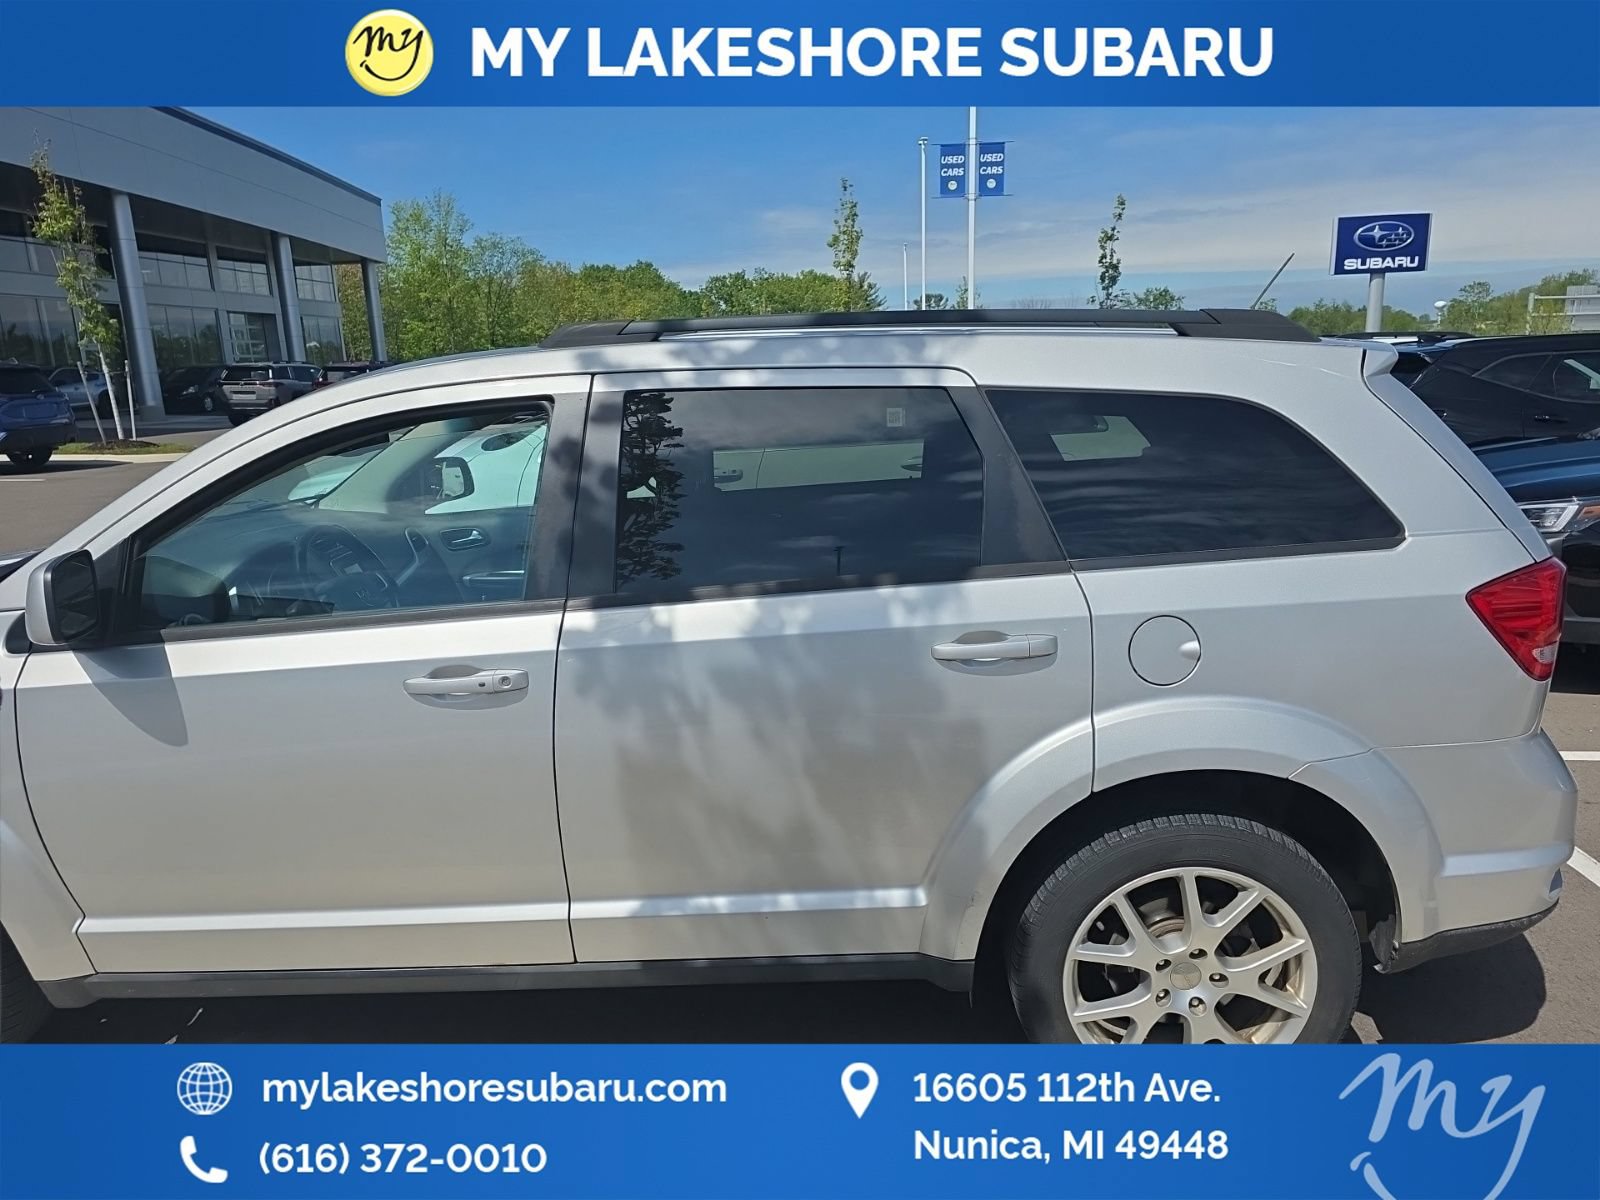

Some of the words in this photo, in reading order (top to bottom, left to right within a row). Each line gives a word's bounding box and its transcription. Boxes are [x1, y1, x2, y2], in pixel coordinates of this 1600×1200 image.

[941, 155, 964, 163] USED
[980, 153, 1003, 162] USED
[941, 168, 964, 176] CARS
[980, 166, 1003, 174] CARS
[1343, 256, 1419, 270] SUBARU
